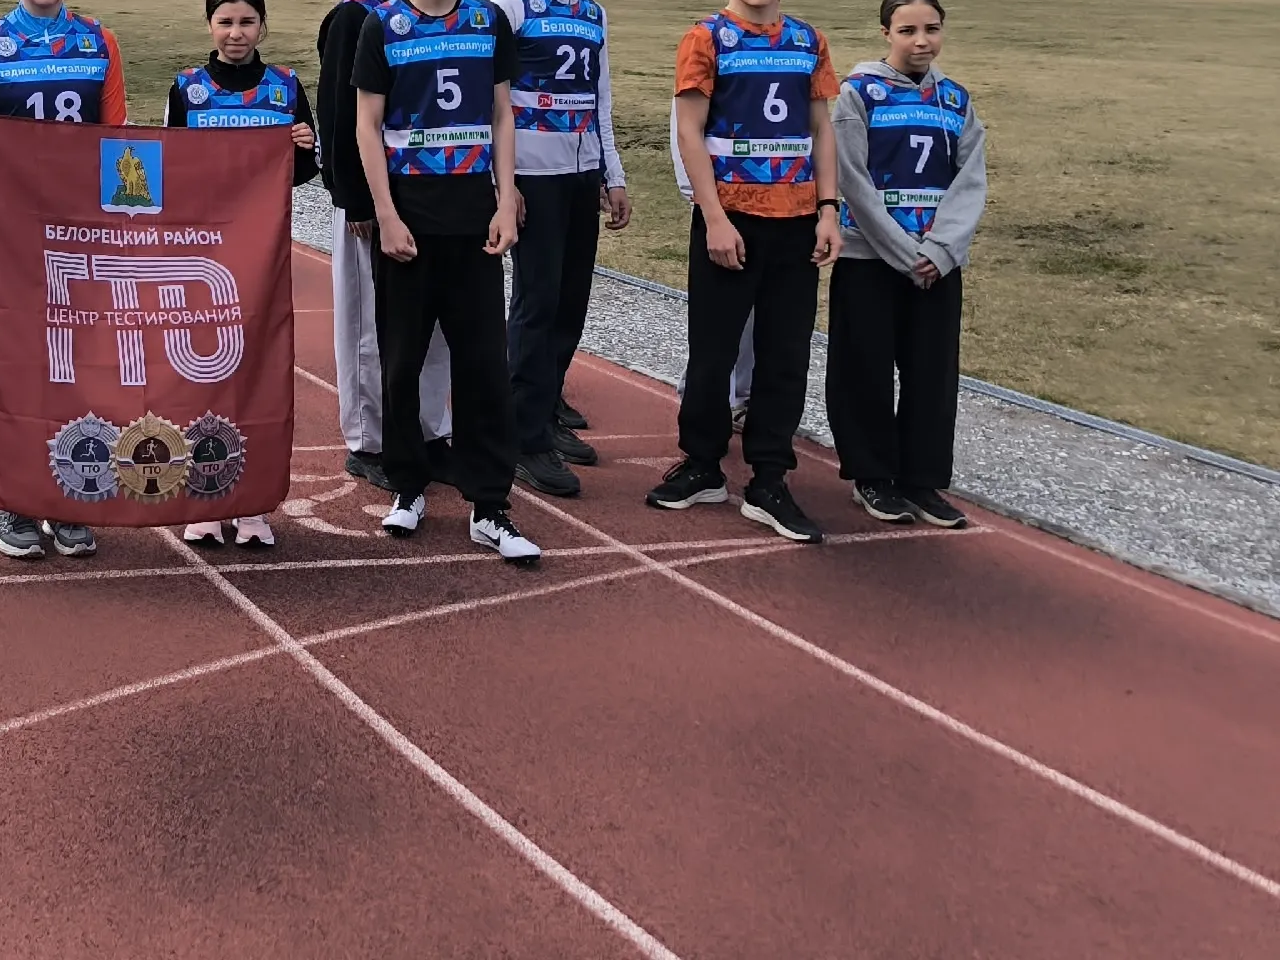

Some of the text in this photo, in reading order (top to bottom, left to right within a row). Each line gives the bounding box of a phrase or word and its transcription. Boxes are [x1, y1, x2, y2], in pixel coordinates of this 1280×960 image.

[541, 19, 596, 39] Белорецк
[391, 45, 432, 57] Стадион
[554, 44, 591, 81] 21
[436, 68, 462, 111] 5
[26, 90, 83, 123] 18
[762, 82, 788, 123] 6
[197, 113, 280, 127] Белорецк
[871, 113, 908, 122] тадион
[909, 134, 934, 174] 7
[45, 224, 223, 248] БЕЛОРЕЦКИЙ РАЙОН
[44, 250, 245, 386] ГТО
[46, 306, 242, 326] ЦЕНТР ТЕСТИРОВАНИЯ
[81, 464, 101, 474] ГТО
[142, 465, 162, 475] ГТО
[202, 463, 220, 473] ГТО
